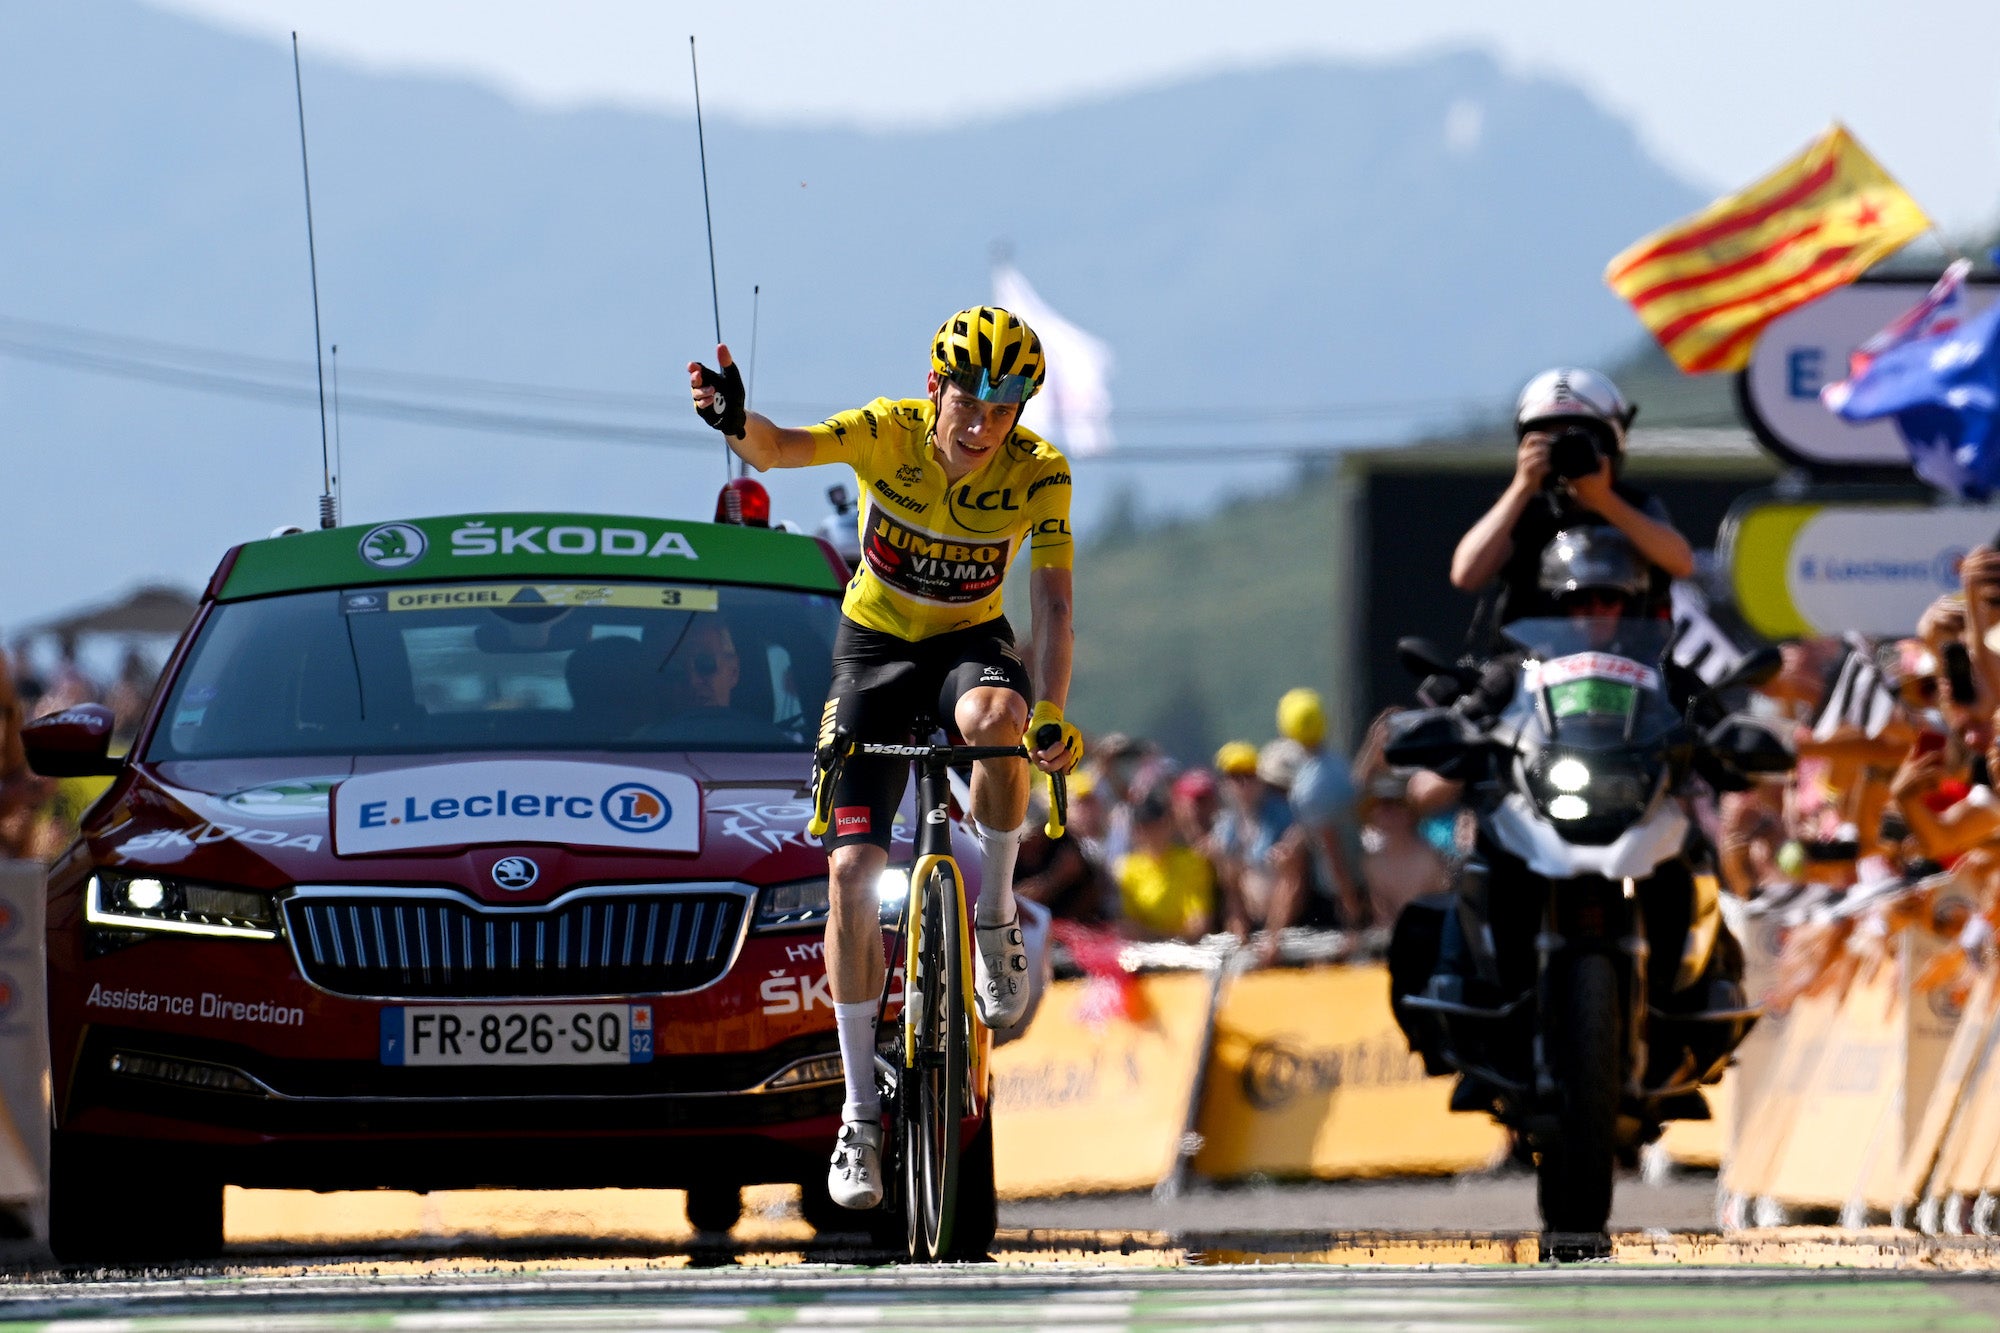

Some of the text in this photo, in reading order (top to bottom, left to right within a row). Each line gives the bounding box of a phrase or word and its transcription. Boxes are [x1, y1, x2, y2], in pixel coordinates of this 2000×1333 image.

[957, 484, 1019, 511] LCL
[451, 521, 699, 560] ŠKODA
[874, 517, 1000, 563] JUMBO
[1031, 518, 1071, 538] LCL
[911, 555, 996, 580] VISMA
[397, 589, 681, 607] OFFICIEL 3
[358, 790, 595, 829] E.Leclerc
[838, 815, 868, 826] HEMA
[86, 982, 305, 1027] Assistance Direction
[412, 1011, 622, 1056] FR-826-SQ
[631, 1034, 650, 1053] 92
